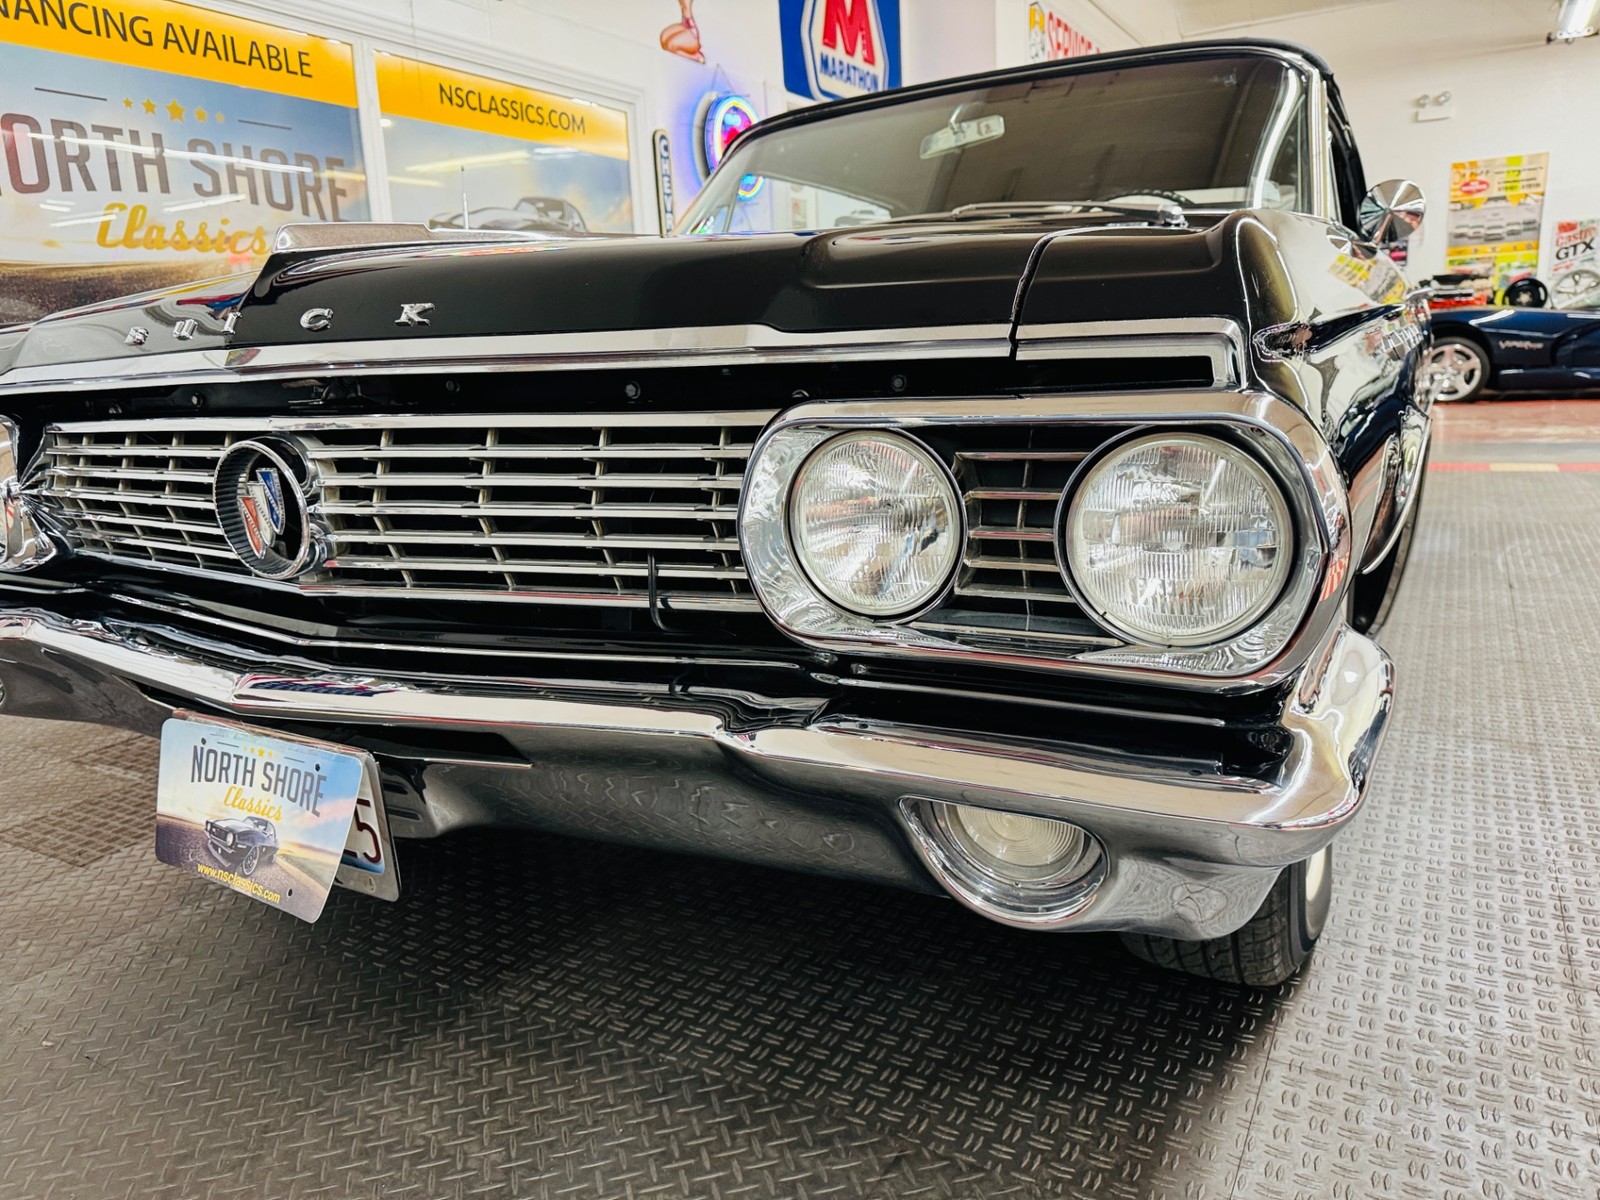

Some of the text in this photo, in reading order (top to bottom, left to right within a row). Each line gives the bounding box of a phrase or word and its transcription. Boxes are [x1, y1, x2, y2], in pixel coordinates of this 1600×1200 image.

[163, 22, 312, 78] AVAILABLE
[820, 52, 878, 92] MARATHON
[439, 82, 586, 135] NSCLASSICS.COM
[0, 112, 347, 222] ORTH SHORE
[96, 202, 268, 255] Classics
[1555, 237, 1595, 260] GTX
[191, 745, 327, 818] NORTH SHORE
[223, 785, 283, 822] Classics
[197, 863, 281, 904] www.nsclassics.com
